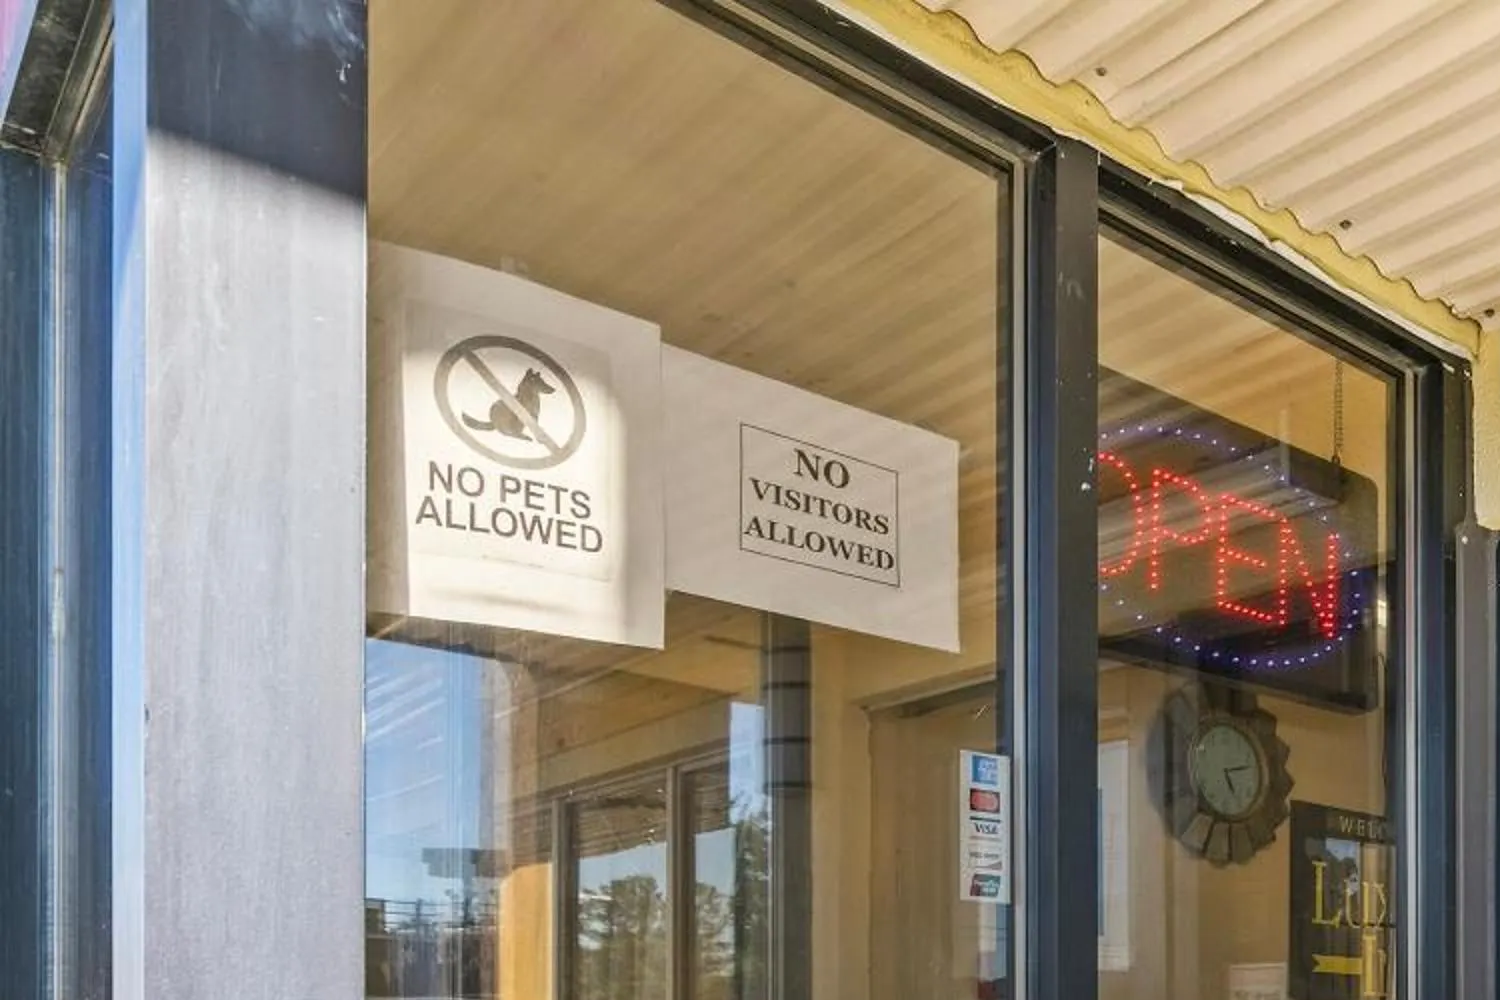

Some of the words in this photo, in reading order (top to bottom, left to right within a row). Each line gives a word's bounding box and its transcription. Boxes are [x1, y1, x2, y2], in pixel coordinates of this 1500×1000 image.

[429, 460, 485, 497] NO
[500, 474, 592, 519] PETS
[795, 448, 849, 488] NO
[415, 495, 603, 553] ALLOWED
[749, 477, 890, 535] VISITORS
[743, 516, 895, 570] ALLOWED
[974, 822, 999, 834] VISA
